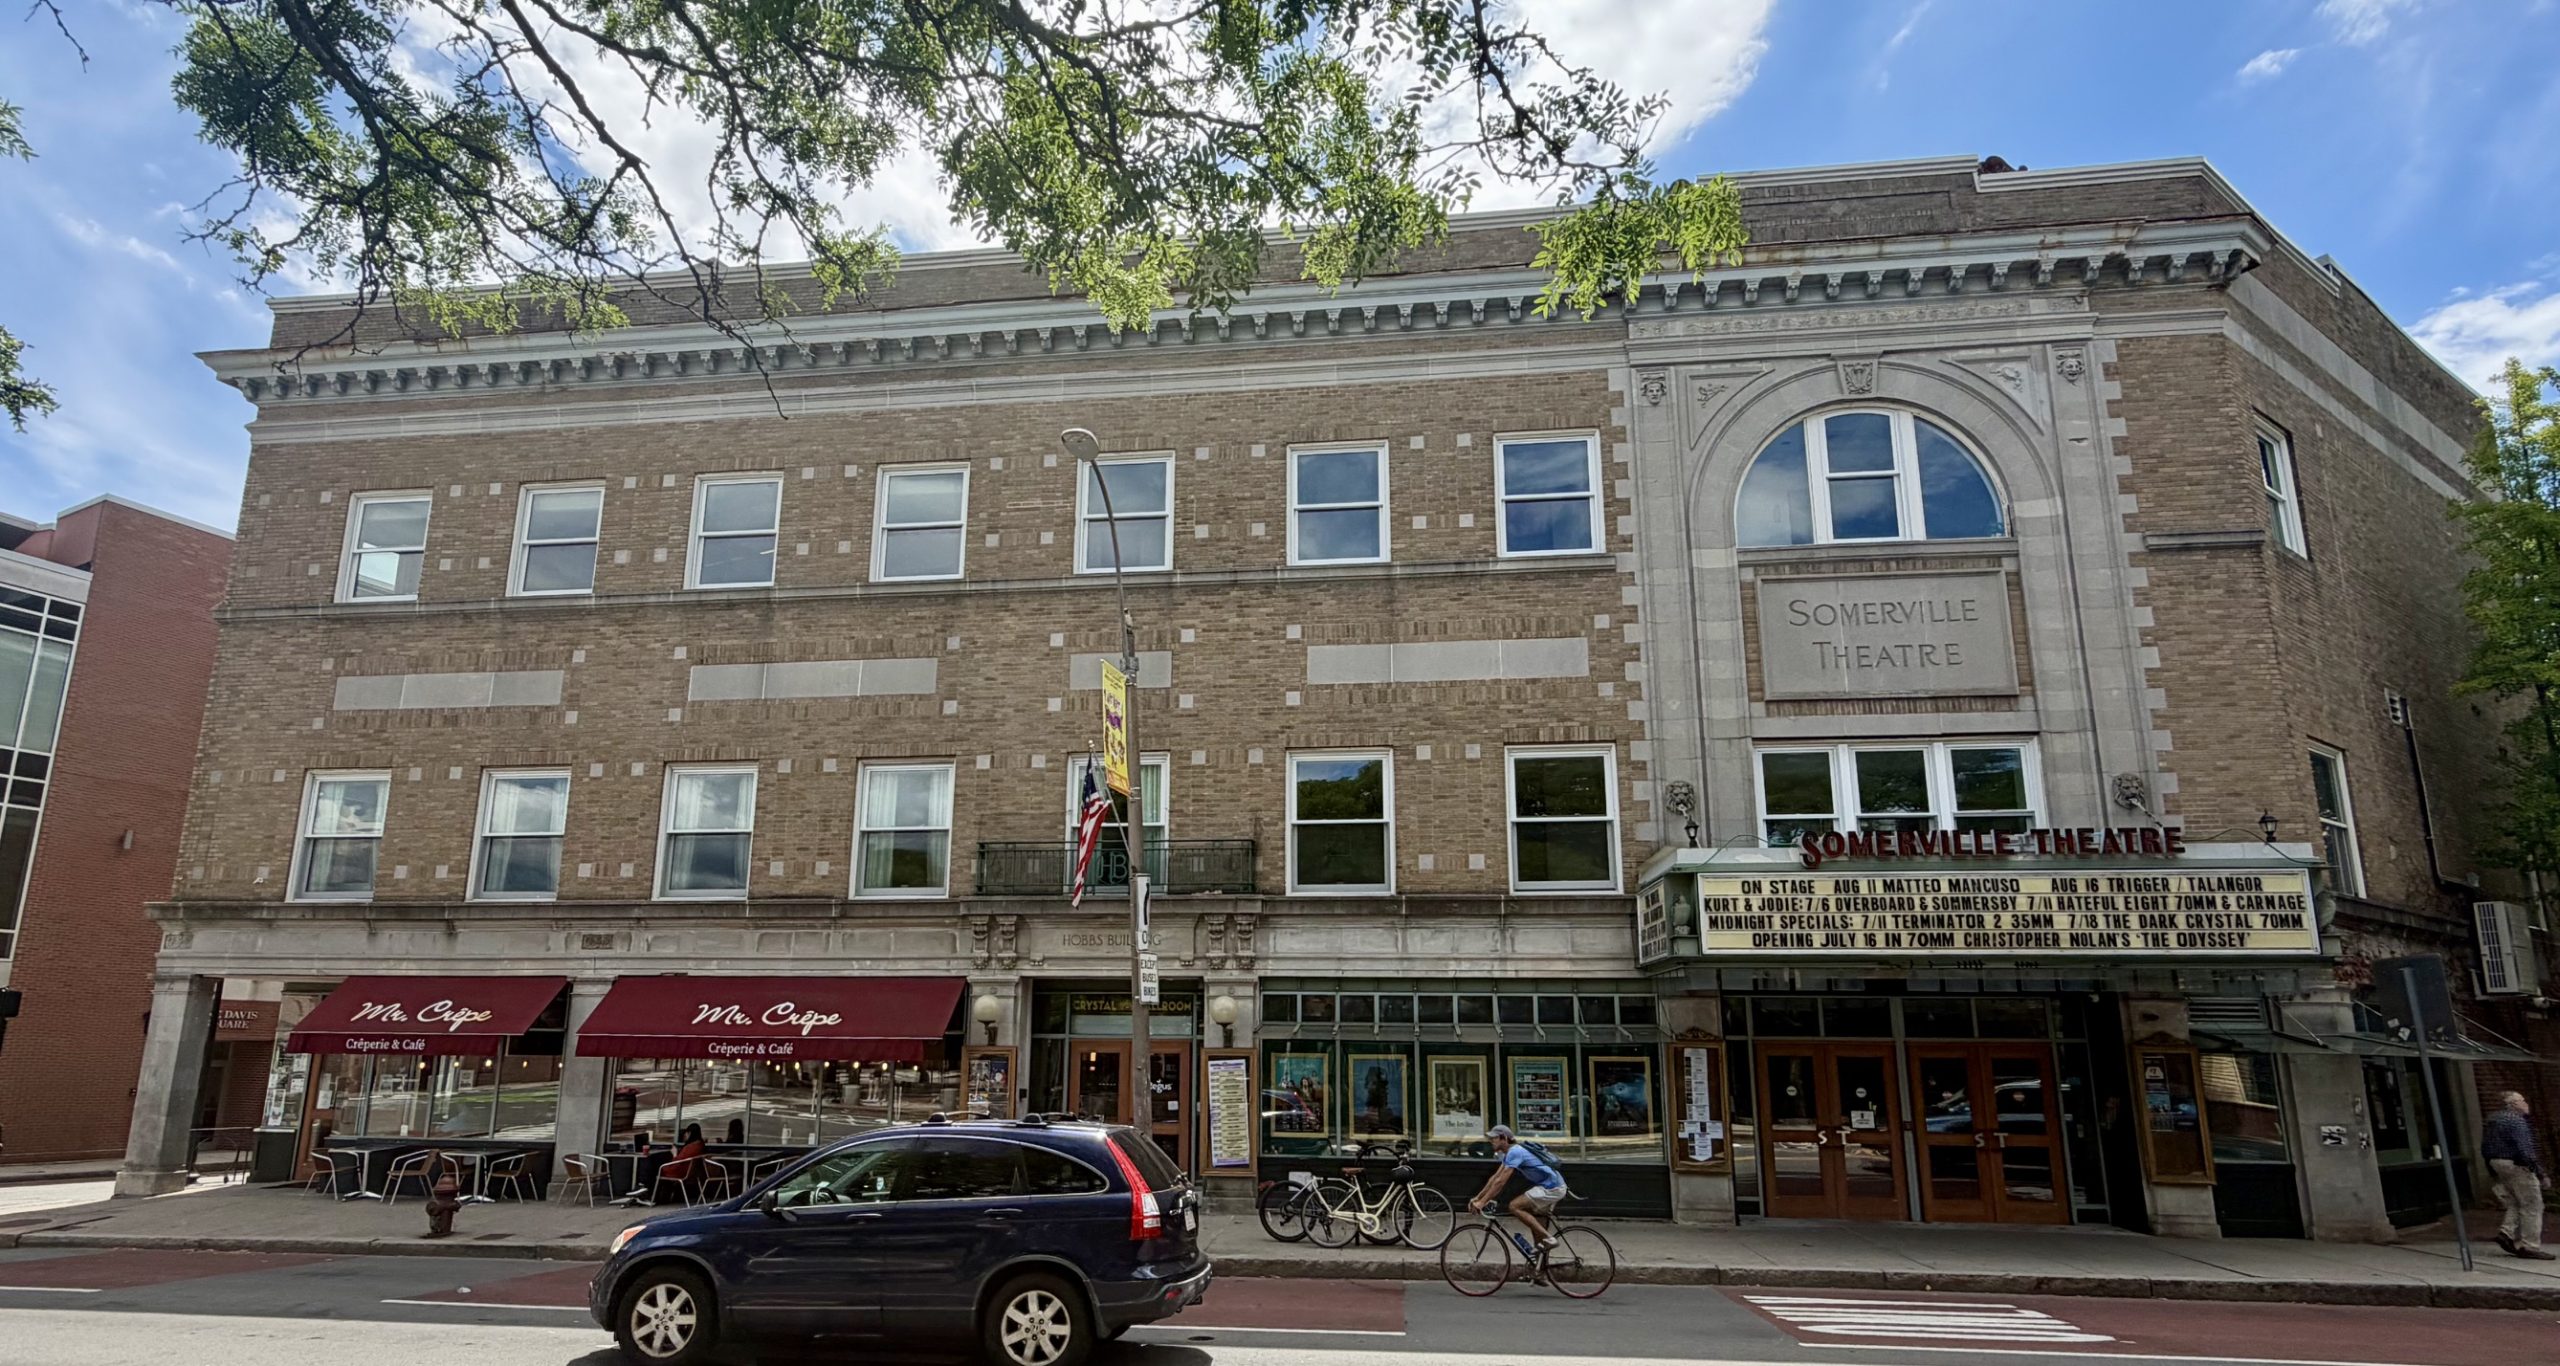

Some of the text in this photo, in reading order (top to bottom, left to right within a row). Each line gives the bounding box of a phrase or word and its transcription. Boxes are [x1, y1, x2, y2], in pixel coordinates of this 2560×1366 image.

[1789, 599, 1979, 626] SOMERVILLE
[1812, 641, 1962, 669] THEATRE
[1801, 827, 2186, 868] SOMERVILLE THEATRE
[1741, 880, 1762, 894] ON
[1770, 880, 1815, 894] STAGE
[1834, 879, 1860, 894] AUG
[1868, 879, 1877, 893] 11
[1883, 878, 1941, 893] MATTEO
[1948, 878, 2020, 893] MANCUSO
[2051, 877, 2078, 893] AUG
[2086, 878, 2099, 892] 16
[2107, 877, 2171, 892] TRIGGER
[2187, 876, 2263, 892] TALANGOR
[1704, 897, 1739, 912] KURT
[1744, 898, 1752, 911] &
[1836, 896, 1915, 912] OVERBOARD
[1920, 897, 1928, 910] &
[2027, 896, 2053, 910] 7/11
[2057, 896, 2119, 910] HATEFUL
[2124, 895, 2169, 911] EIGHT
[2175, 895, 2217, 910] 70MM
[2222, 896, 2231, 910] &
[2236, 895, 2306, 910] CARNAGE
[1709, 913, 2304, 930] MIDNIGHT SPECIALS: 7/11 TERMINATOR 2 35MM 7/18 THE DARK CRYSTAL 70MM
[1062, 934, 1104, 946] HOBBS
[1107, 934, 1162, 946] BUILG
[1752, 933, 1813, 947] OPENING
[1820, 933, 1856, 947] JULY
[1863, 933, 1877, 947] 16
[1885, 933, 1902, 947] IN
[2069, 932, 2131, 948] NOLAN'S
[1073, 1001, 1117, 1011] CRYSTAL
[224, 1010, 259, 1020] DAVIS
[350, 999, 493, 1032] Mr. Crêpe
[691, 1001, 843, 1036] Mr. Crêpe
[218, 1020, 250, 1029] UARE
[345, 1038, 426, 1052] Crêperie & Café
[708, 1042, 794, 1057] Crêperie & Café
